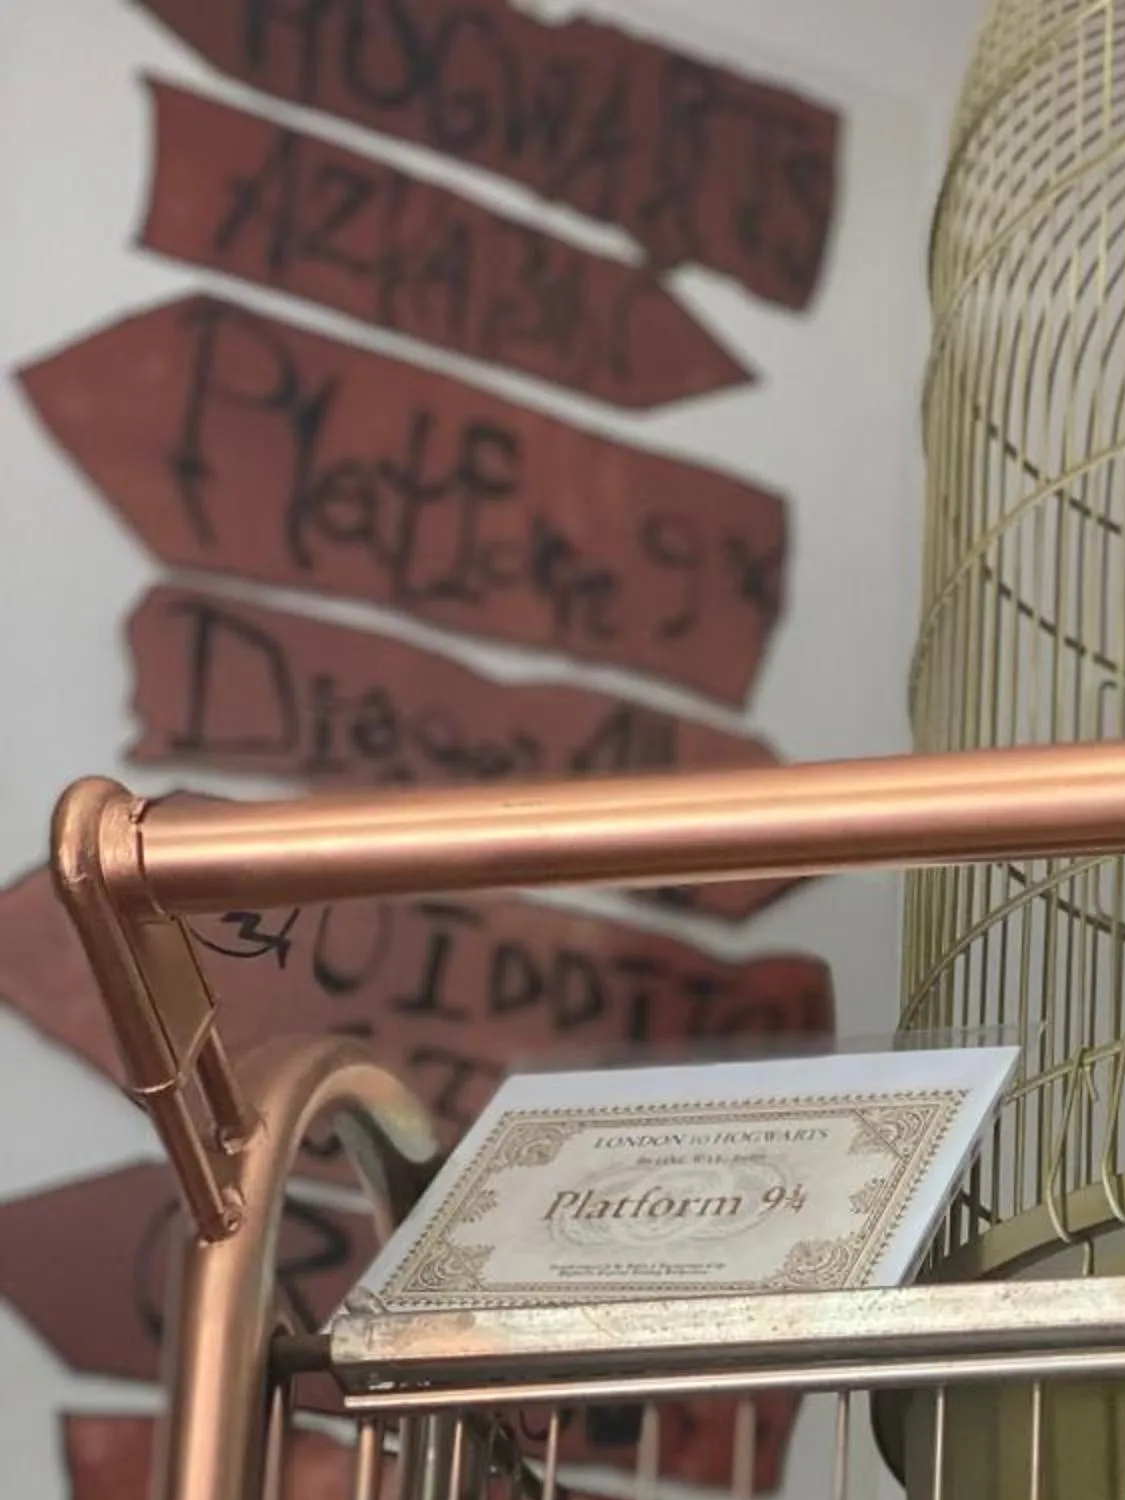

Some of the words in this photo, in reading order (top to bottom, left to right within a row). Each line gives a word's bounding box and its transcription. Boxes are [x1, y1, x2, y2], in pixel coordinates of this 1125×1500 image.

[593, 1133, 682, 1149] LONDON
[713, 1127, 830, 1145] HOGWARTS
[542, 1184, 743, 1221] Platform
